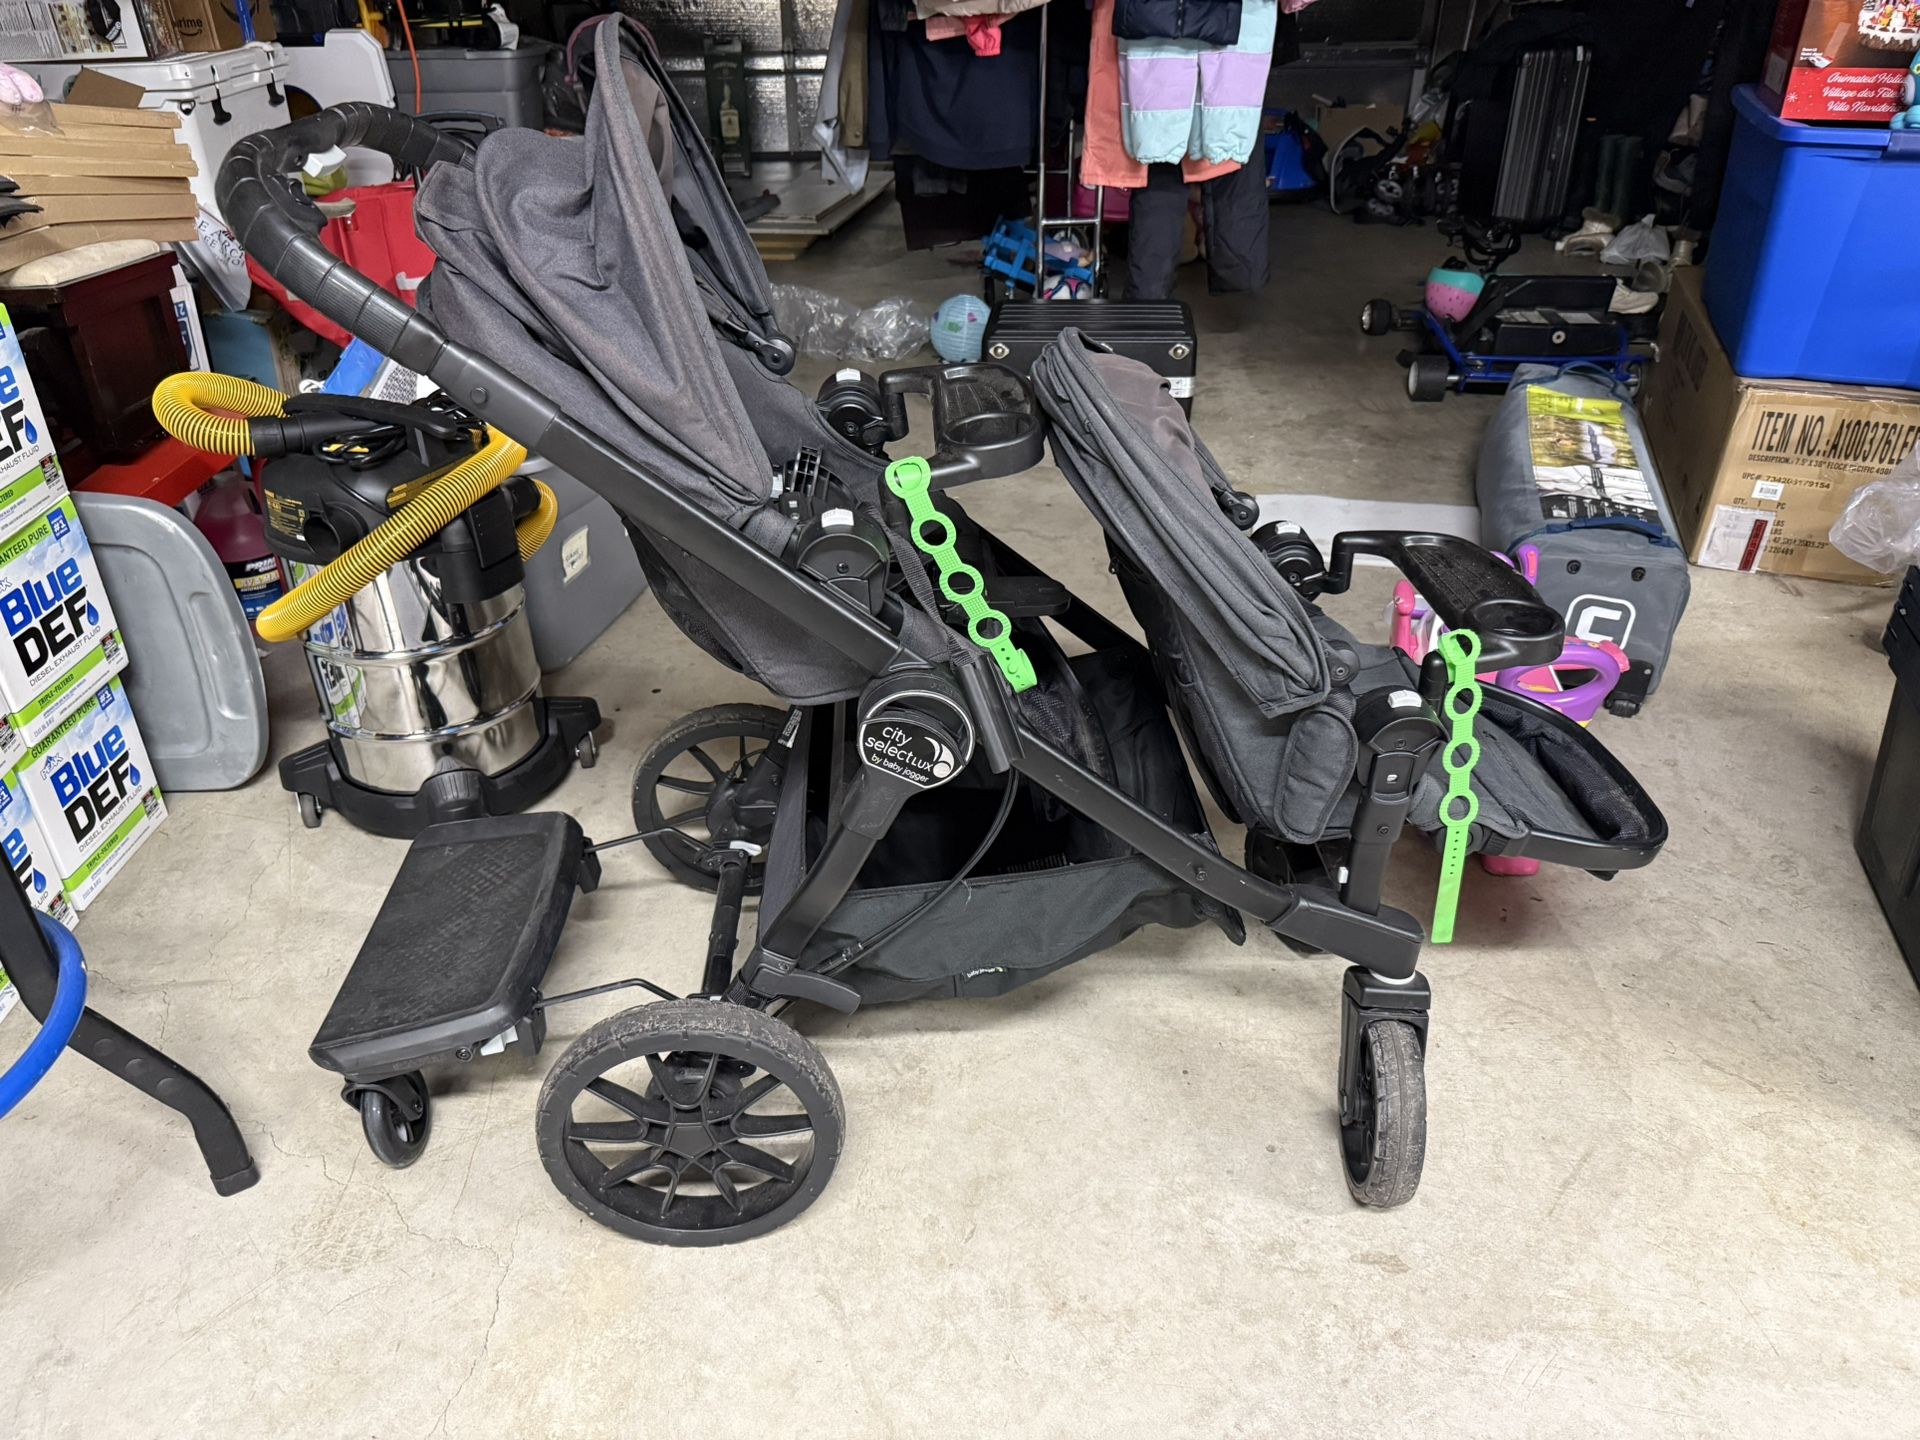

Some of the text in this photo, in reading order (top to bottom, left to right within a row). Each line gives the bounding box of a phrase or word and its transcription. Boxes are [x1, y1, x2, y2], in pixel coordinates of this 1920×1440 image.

[1822, 86, 1857, 99] Village
[1857, 88, 1876, 98] des
[1827, 72, 1879, 84] Animated
[1827, 101, 1850, 112] Villa
[1752, 411, 1797, 454] ITEM
[22, 445, 39, 460] FLUID
[1776, 502, 1787, 510] PC
[0, 524, 50, 566] ANTEED PURE
[246, 557, 277, 573] PRIM
[0, 557, 83, 637] Blue
[13, 586, 88, 678] DEF
[29, 664, 56, 687] DIESEL
[54, 640, 85, 668] EXHAUST
[84, 625, 102, 644] FLUID
[31, 714, 78, 760] GUARANTEED
[77, 696, 98, 720] PURE
[882, 726, 913, 747] city
[40, 752, 64, 781] PEAK
[50, 724, 127, 809] Blue
[871, 753, 930, 783] by baby jogger
[63, 750, 130, 844] DEF
[79, 829, 103, 853] DIESEL
[100, 802, 128, 832] EXHAUST
[126, 784, 143, 805] FLUID
